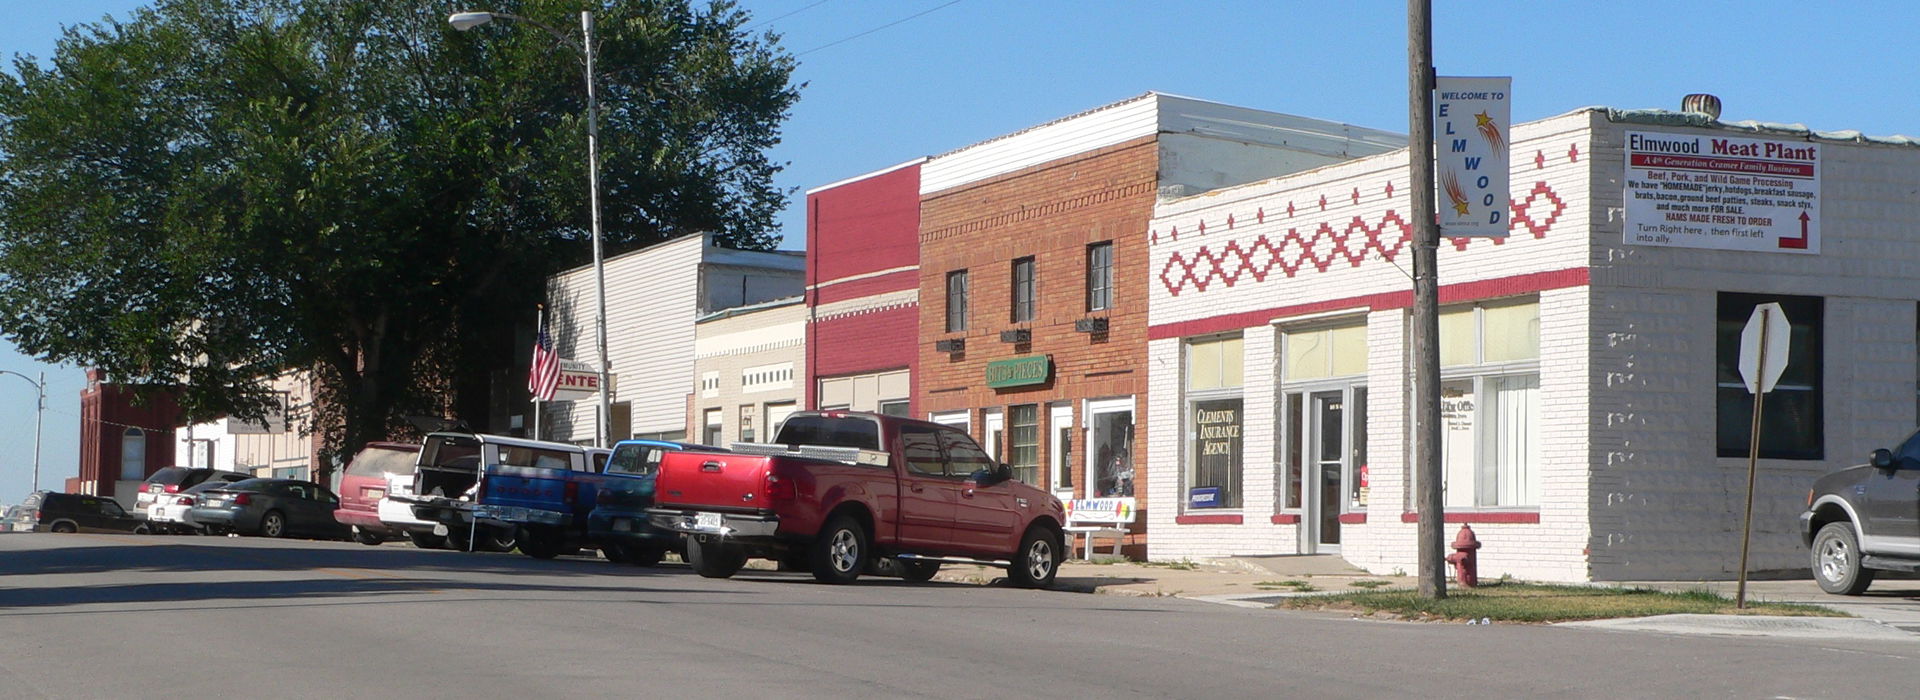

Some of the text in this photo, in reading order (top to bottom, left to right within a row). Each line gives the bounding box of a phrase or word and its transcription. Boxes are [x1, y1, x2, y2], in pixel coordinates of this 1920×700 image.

[1442, 92, 1504, 100] WELCOME TO
[1630, 134, 1816, 160] Elmwood Meat Plant
[1439, 104, 1501, 225] ELMWOOD
[1665, 157, 1707, 167] Generation
[1740, 161, 1766, 173] Family
[1767, 164, 1801, 174] Business
[1648, 171, 1669, 181] Beef,
[1694, 174, 1708, 182] and
[1710, 174, 1728, 184] Wild
[1730, 176, 1751, 185] Game
[1753, 177, 1794, 189] Processing
[1628, 180, 1640, 189] We
[1641, 181, 1658, 189] have
[1787, 190, 1816, 199] sausage,
[1656, 203, 1670, 211] and
[1671, 204, 1690, 212] much
[1711, 205, 1724, 213] FOR
[1705, 194, 1721, 203] beef
[1722, 196, 1749, 205] patties,
[1750, 198, 1775, 207] steaks,
[1777, 199, 1796, 208] snack
[1665, 213, 1772, 227] HAMS MADE FRESH TO ORDER
[1636, 233, 1654, 242] into
[1638, 223, 1658, 232] Turn
[1660, 224, 1682, 234] Right
[1684, 225, 1703, 234] here
[1711, 227, 1730, 236] then
[1732, 228, 1748, 237] first
[1750, 229, 1764, 238] left
[1015, 360, 1043, 379] PIECES
[558, 374, 597, 387] ENTE
[1197, 408, 1234, 424] CLEMENTS
[1200, 424, 1240, 440] INSURANCE
[1075, 500, 1114, 511] ELMWOOD
